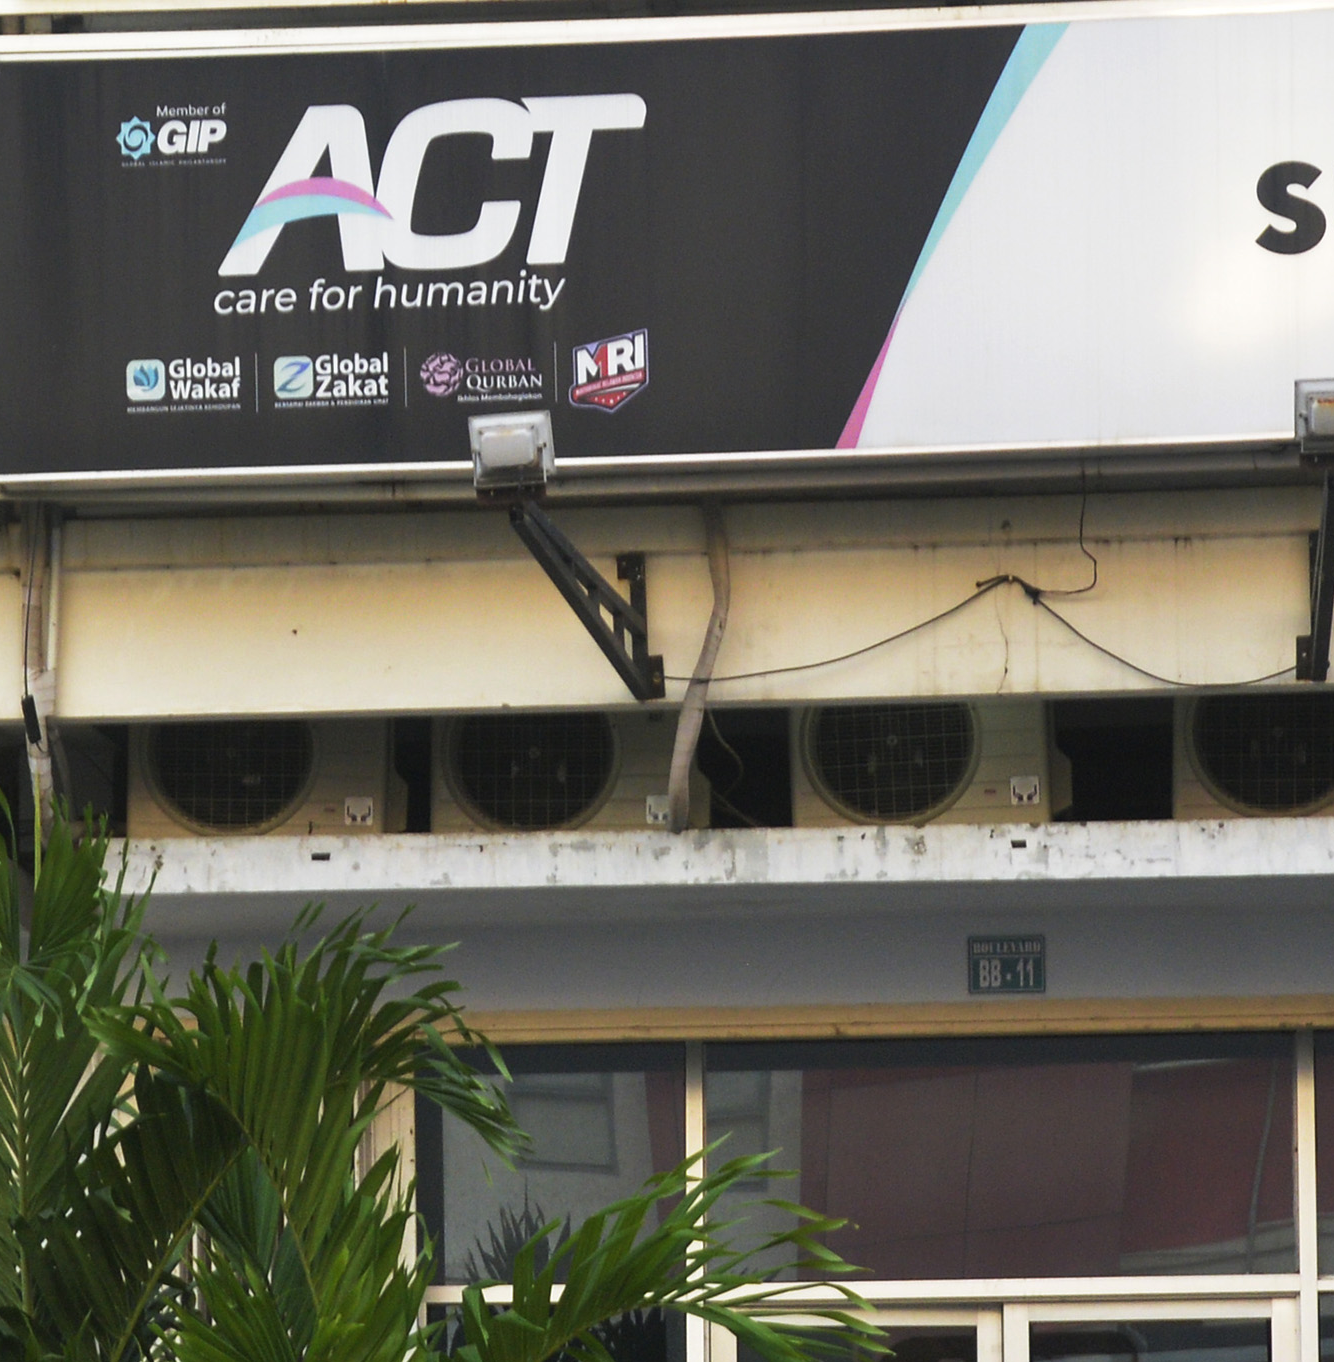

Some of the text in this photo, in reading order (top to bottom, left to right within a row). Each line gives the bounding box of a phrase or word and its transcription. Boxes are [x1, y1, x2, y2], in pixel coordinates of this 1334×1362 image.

[156, 102, 227, 117] Member of
[157, 119, 227, 155] GIP
[218, 93, 647, 276] ACT
[213, 269, 566, 315] care for humanity
[169, 356, 241, 379] Global
[315, 352, 389, 375] Global
[466, 358, 536, 373] GLOBAL
[577, 333, 645, 384] MRI
[169, 376, 241, 400] Wakaf
[316, 373, 389, 398] Zakat
[467, 373, 543, 392] QURBAN
